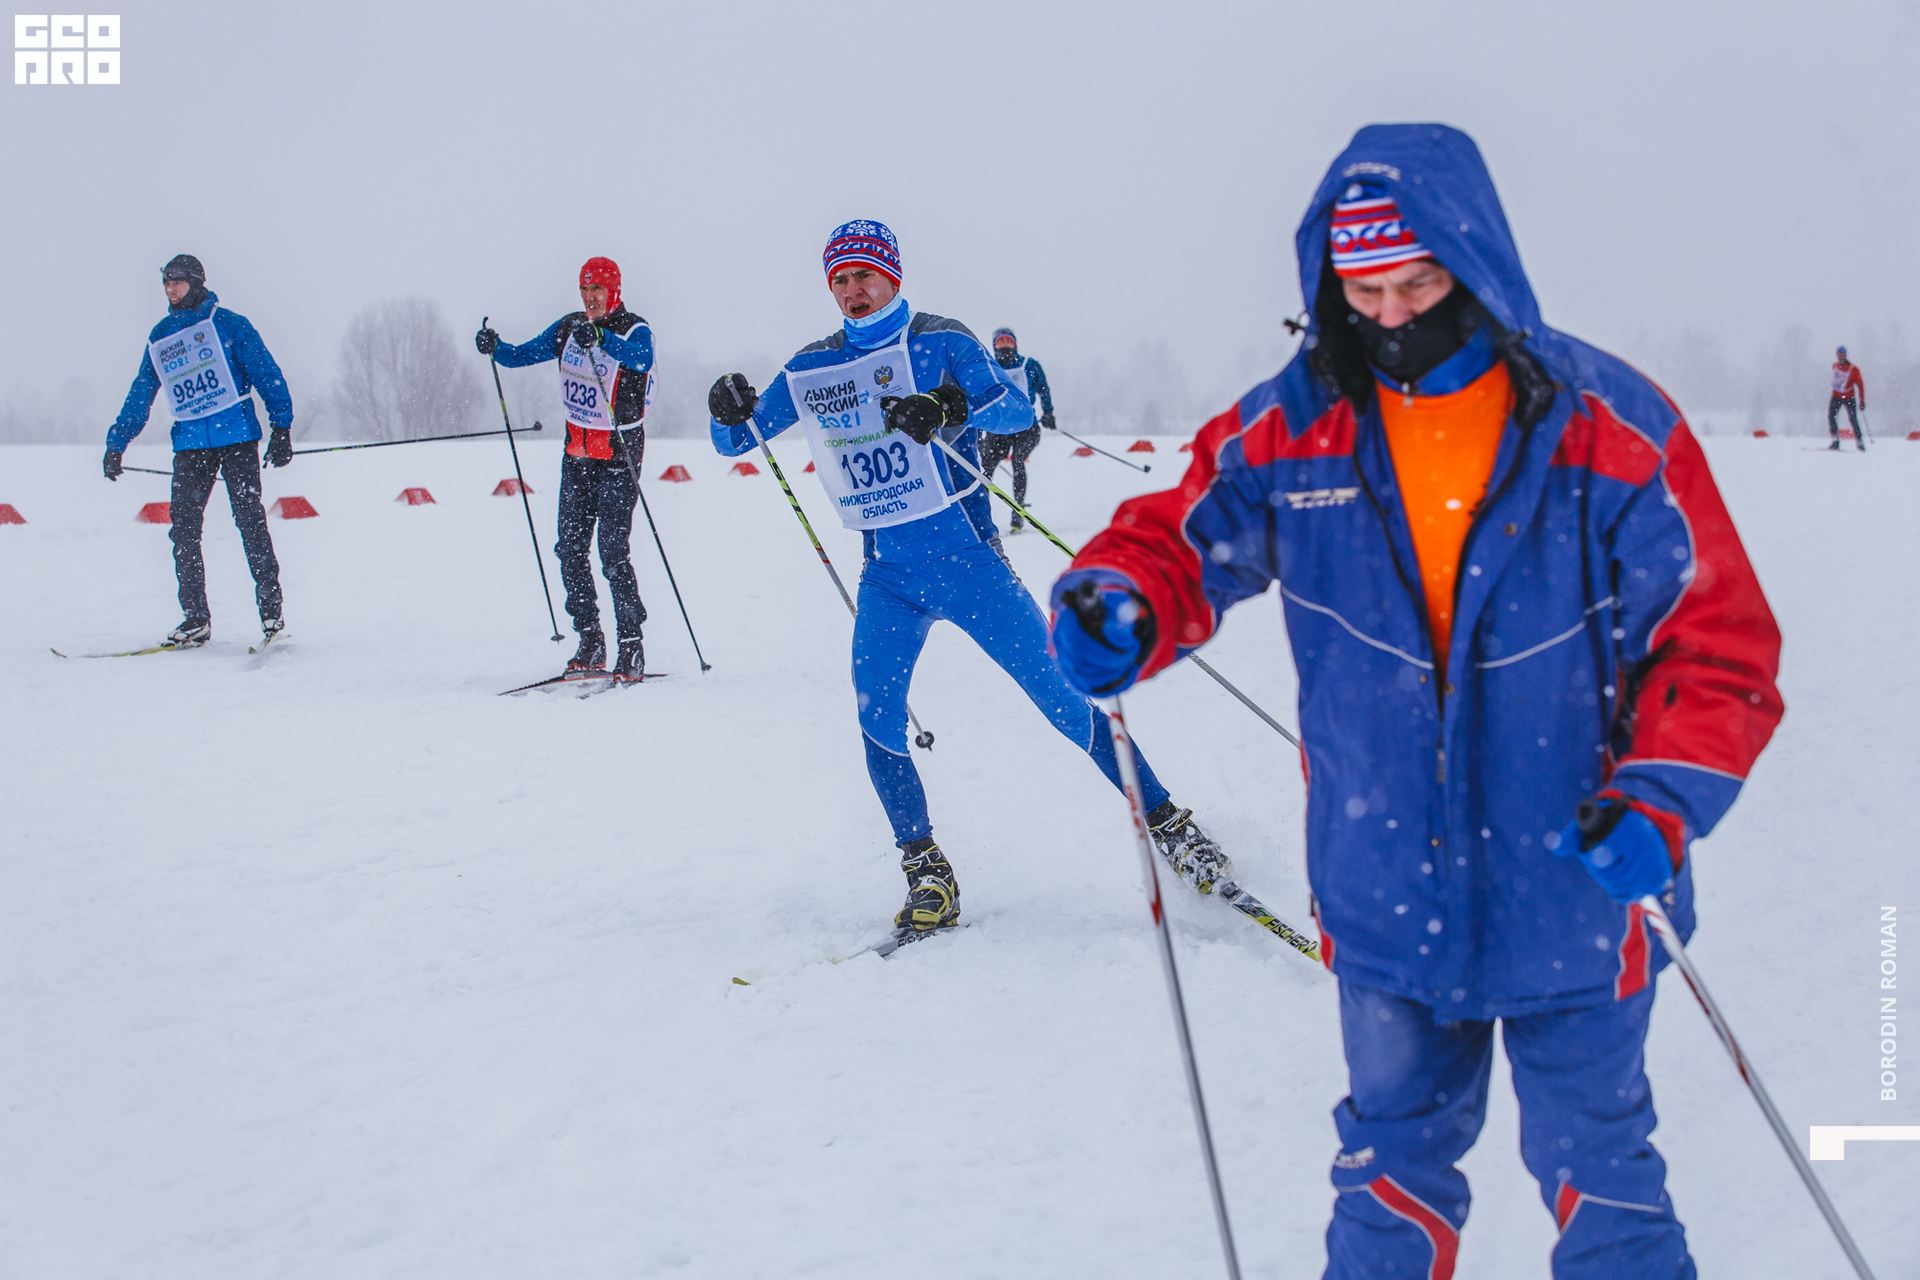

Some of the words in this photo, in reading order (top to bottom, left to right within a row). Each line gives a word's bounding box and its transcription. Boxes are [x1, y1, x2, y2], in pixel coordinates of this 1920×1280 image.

[173, 369, 219, 404] 9848
[564, 379, 597, 409] 1238
[804, 380, 857, 402] ЛЫЖНЯ
[807, 394, 860, 415] РОССИИ
[817, 410, 861, 430] 2021
[823, 438, 848, 448] СПОРТ
[853, 431, 881, 446] НОРМА
[842, 441, 910, 490] 1303
[839, 477, 924, 507] НИЖЕГОРОДСКАЯ
[862, 502, 908, 519] ОБЛАСТЬ
[1264, 918, 1311, 951] FISCHER
